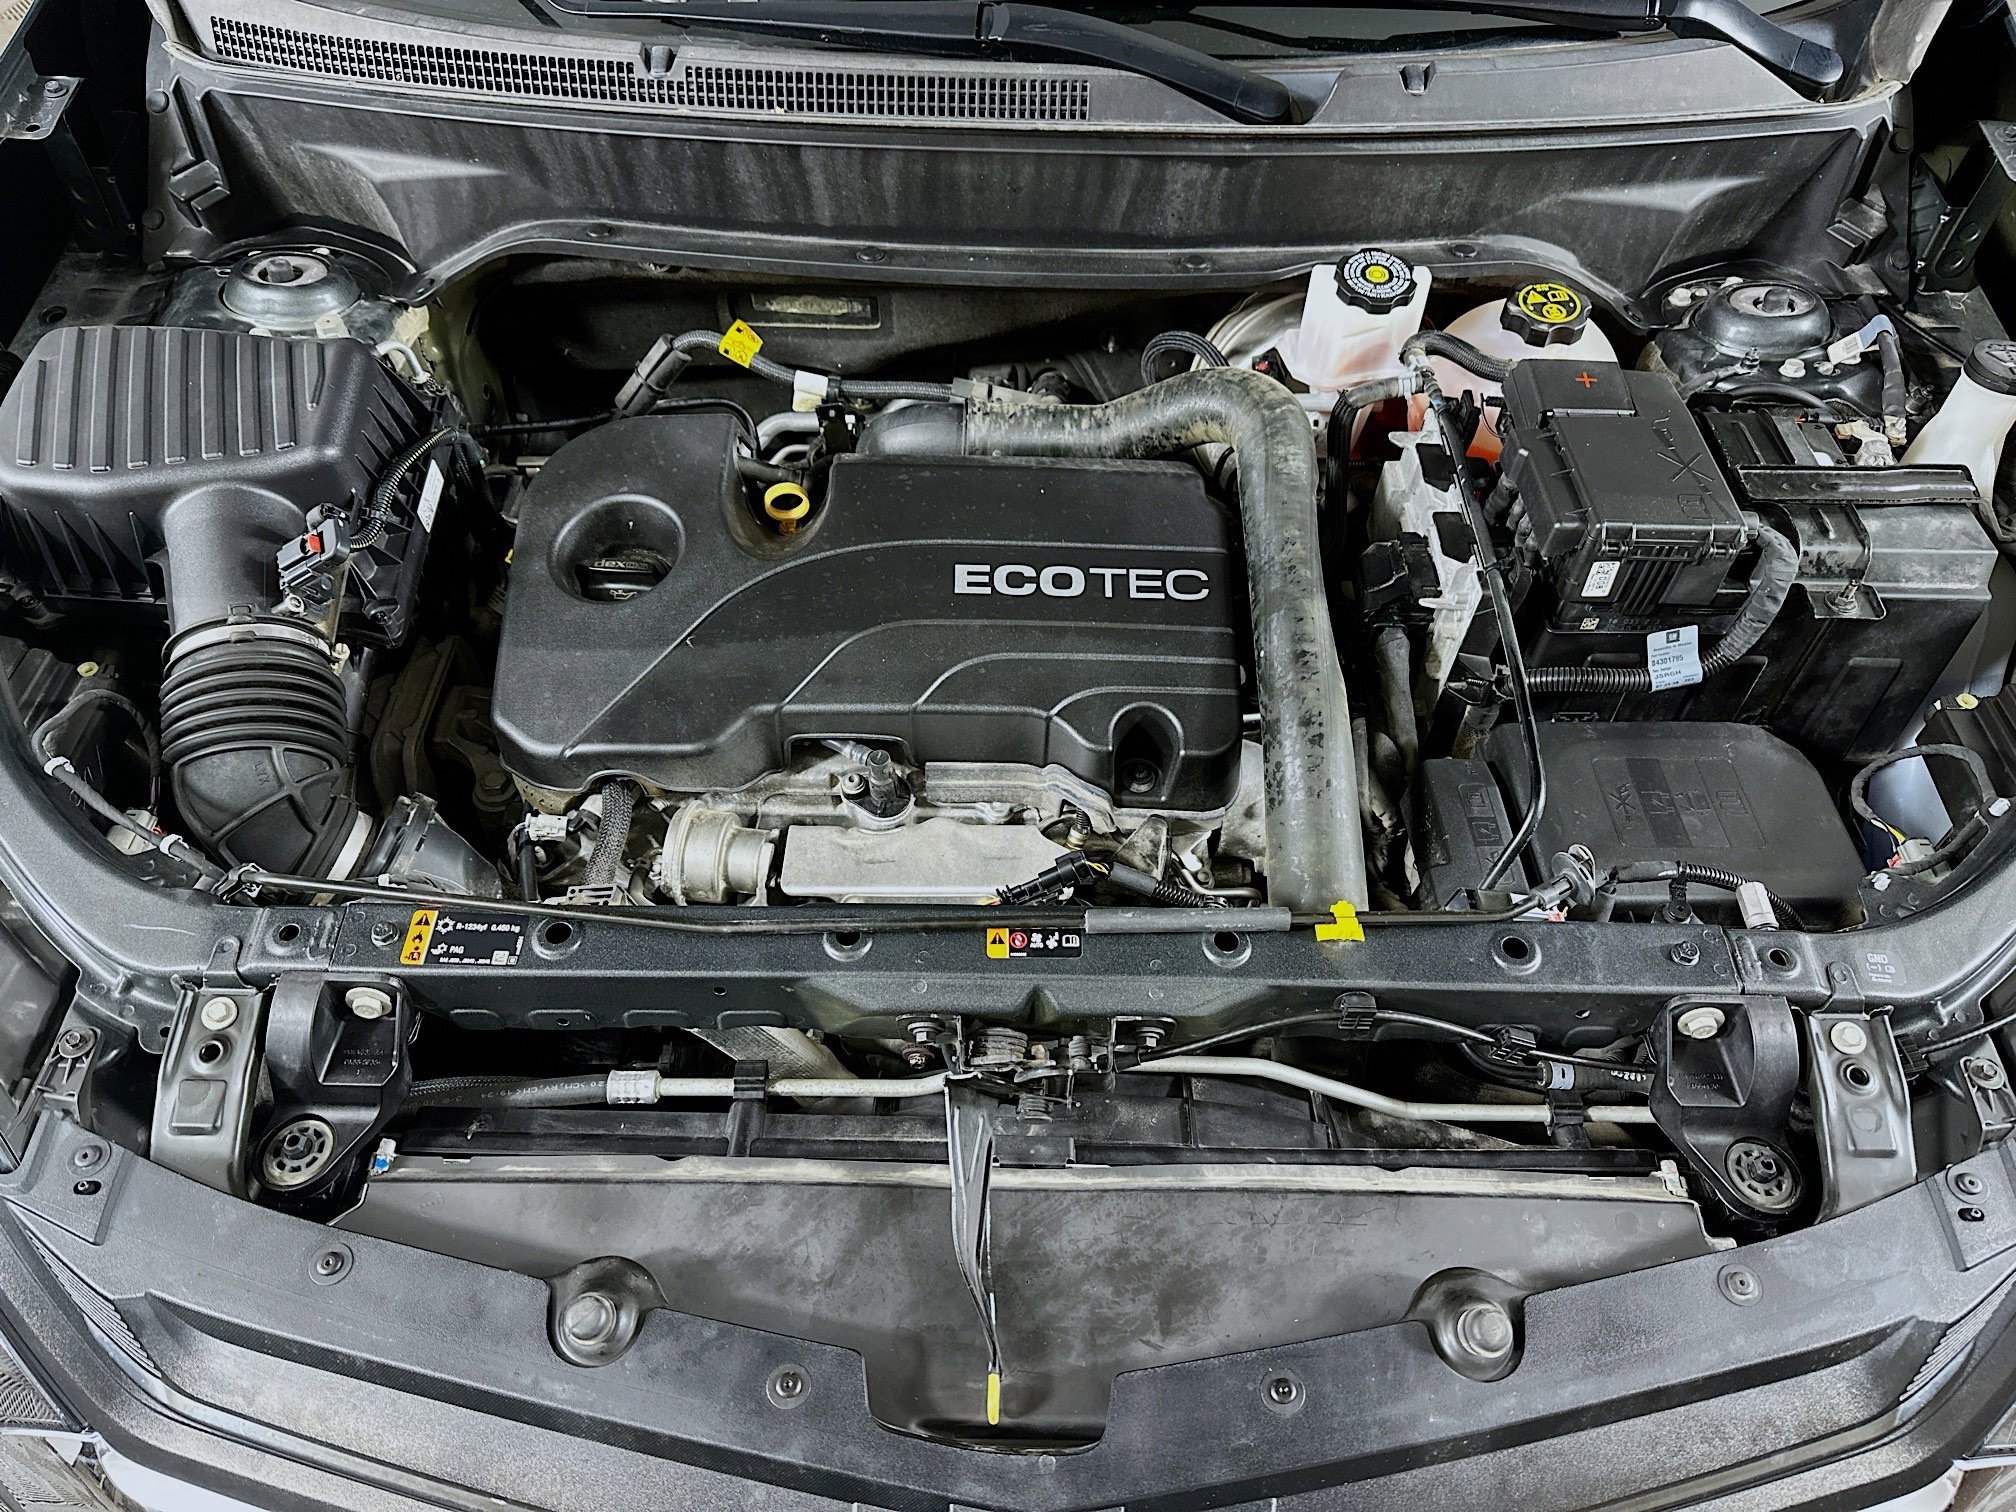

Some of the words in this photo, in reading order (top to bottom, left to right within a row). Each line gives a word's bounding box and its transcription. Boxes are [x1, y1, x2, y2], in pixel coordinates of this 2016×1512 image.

[954, 564, 1210, 601] ECOTEC
[1651, 654, 1684, 667] 84301795
[449, 945, 465, 954] PAG
[1866, 952, 1889, 964] GND
